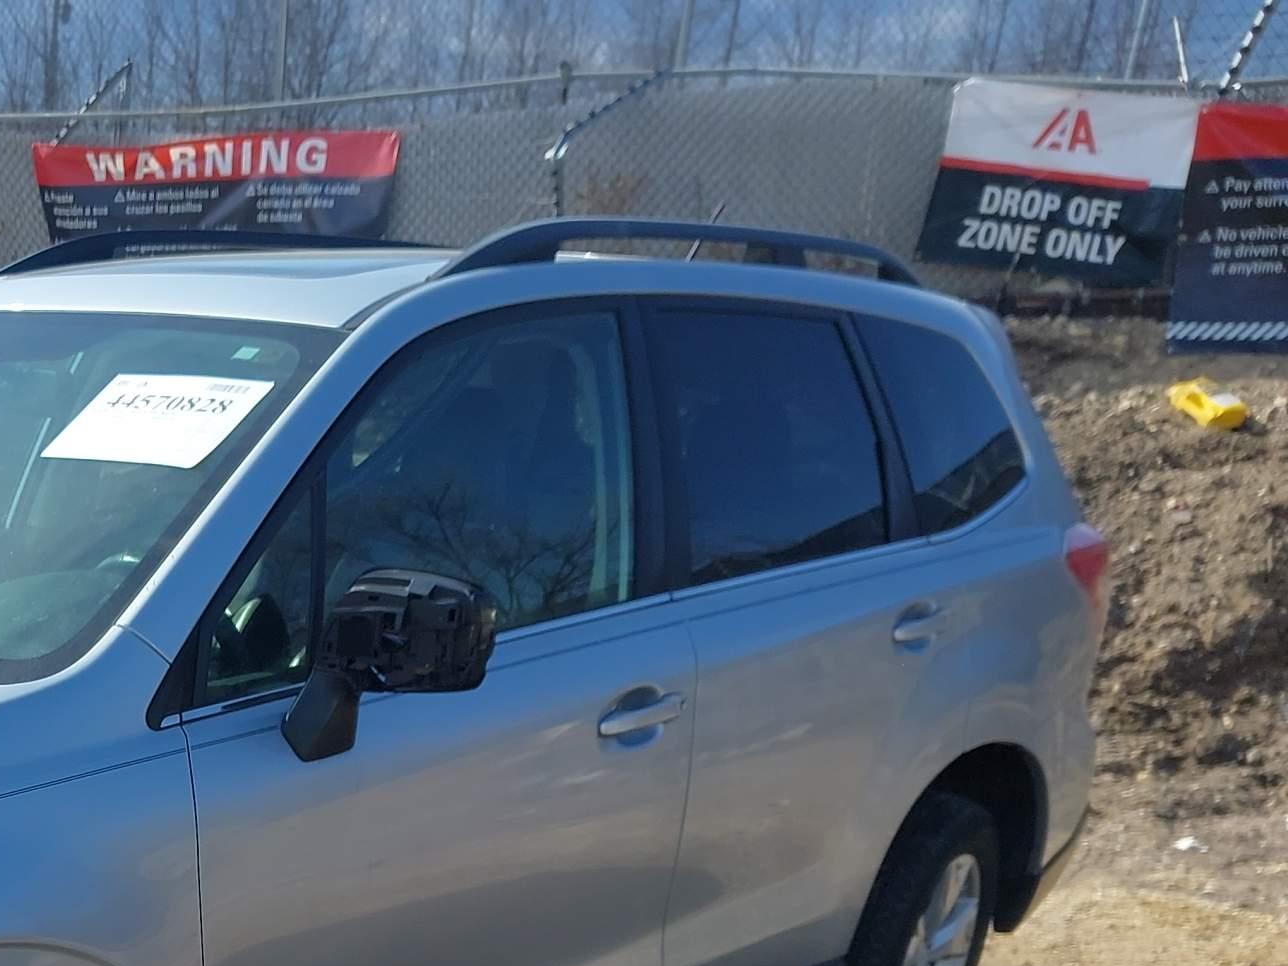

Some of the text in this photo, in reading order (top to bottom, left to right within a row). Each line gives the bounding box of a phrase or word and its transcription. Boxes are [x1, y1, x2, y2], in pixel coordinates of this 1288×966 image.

[86, 138, 328, 182] WARNING
[1224, 176, 1251, 194] Pay
[980, 185, 1122, 230] DROP OFF
[1221, 197, 1252, 212] your
[957, 218, 1125, 265] ZONE ONLY
[1216, 227, 1237, 242] No
[1215, 246, 1232, 258] be
[1234, 243, 1279, 258] driven
[1212, 262, 1226, 275] at
[107, 393, 233, 414] 44570828
